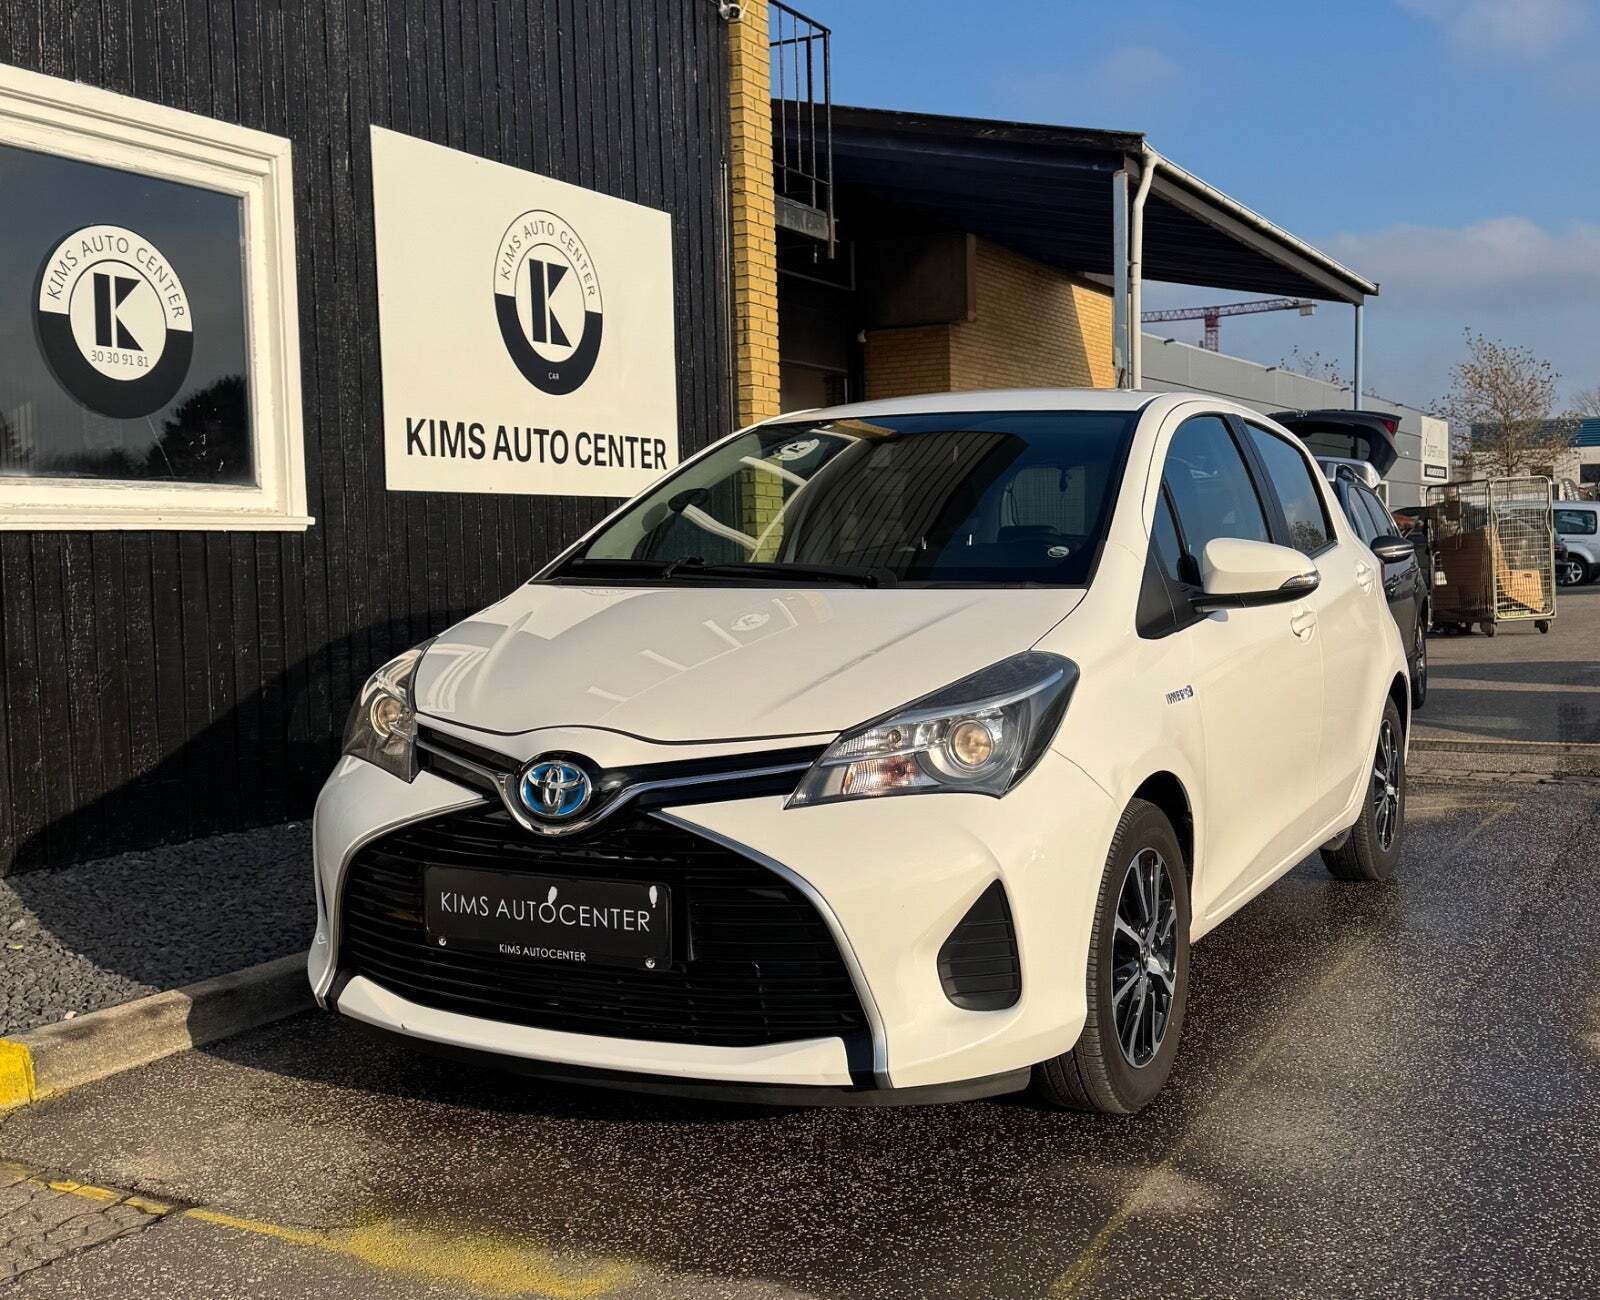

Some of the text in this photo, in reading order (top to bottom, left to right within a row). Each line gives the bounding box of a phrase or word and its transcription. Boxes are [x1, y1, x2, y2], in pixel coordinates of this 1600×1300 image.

[47, 235, 185, 319] KIMS AUTO CENTER
[500, 220, 596, 297] KIMS AUTO CENTER
[91, 350, 149, 368] 30 30 91 81
[405, 417, 667, 471] KIMS AUTO CENTER
[440, 891, 651, 932] KIMS AUTOCENTER
[499, 943, 587, 962] KIMS AUTOCENTER
